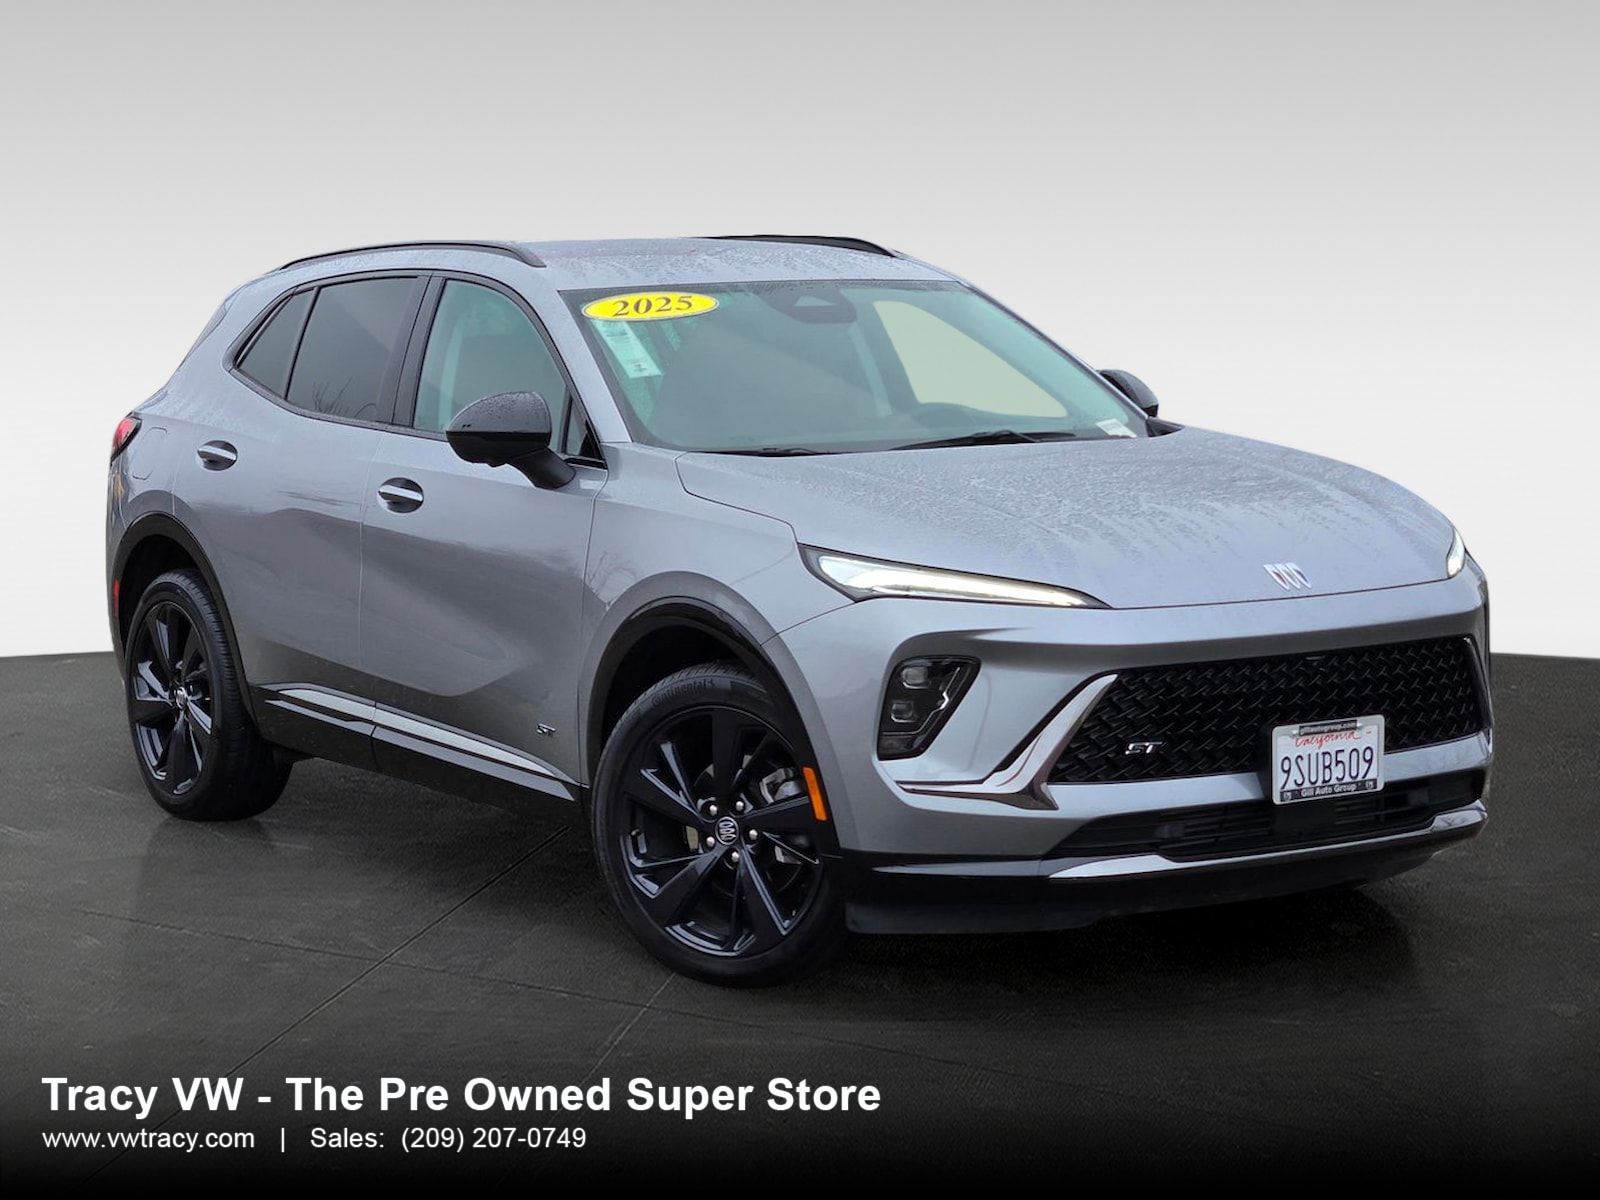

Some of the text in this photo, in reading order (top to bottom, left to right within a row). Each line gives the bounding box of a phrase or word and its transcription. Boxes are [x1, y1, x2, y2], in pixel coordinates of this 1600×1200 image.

[612, 295, 693, 317] 2025
[1280, 746, 1374, 790] 9SUB509
[1301, 783, 1357, 797] Gill Auto Group
